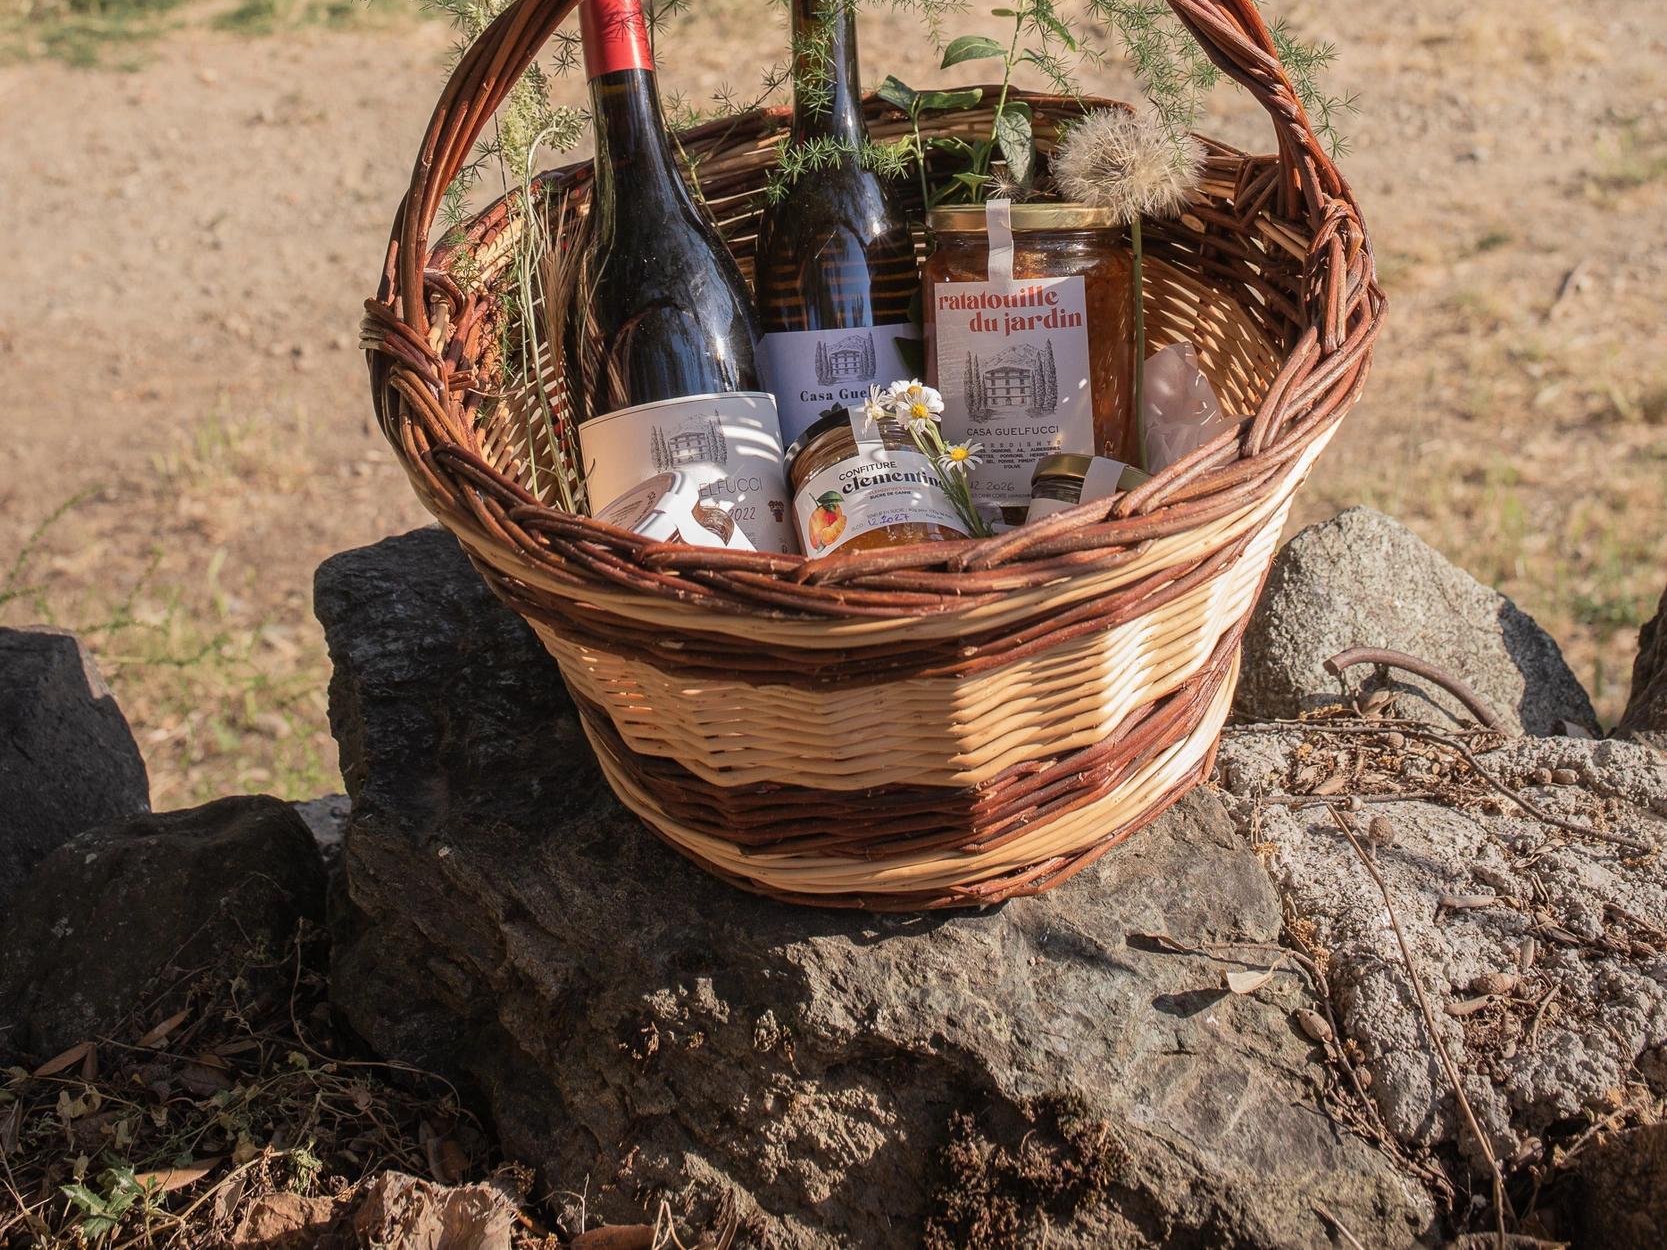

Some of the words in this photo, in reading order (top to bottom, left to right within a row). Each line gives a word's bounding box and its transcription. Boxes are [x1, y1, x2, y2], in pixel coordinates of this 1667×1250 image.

[939, 286, 1059, 310] ratatouille
[969, 312, 998, 332] du
[1003, 308, 1082, 336] jardin
[800, 391, 833, 402] Casa
[966, 428, 992, 437] CASA
[995, 425, 1059, 436] GUELFUCCI
[838, 461, 898, 481] CONFITURE
